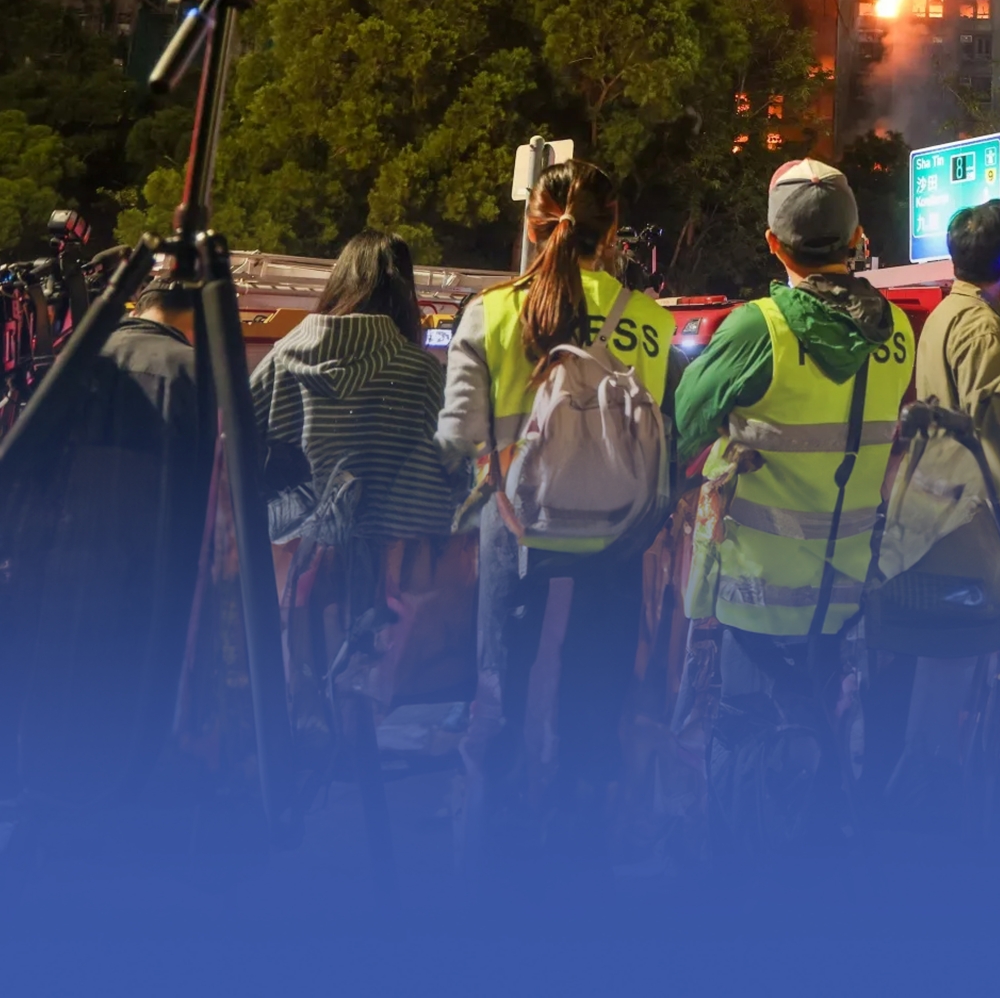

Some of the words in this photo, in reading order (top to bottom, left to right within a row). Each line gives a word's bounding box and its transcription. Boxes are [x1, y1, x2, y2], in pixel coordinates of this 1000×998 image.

[916, 158, 931, 171] Sha
[932, 154, 945, 167] Tin
[956, 157, 963, 179] 8
[916, 174, 938, 193] 沙田
[987, 169, 994, 181] 9
